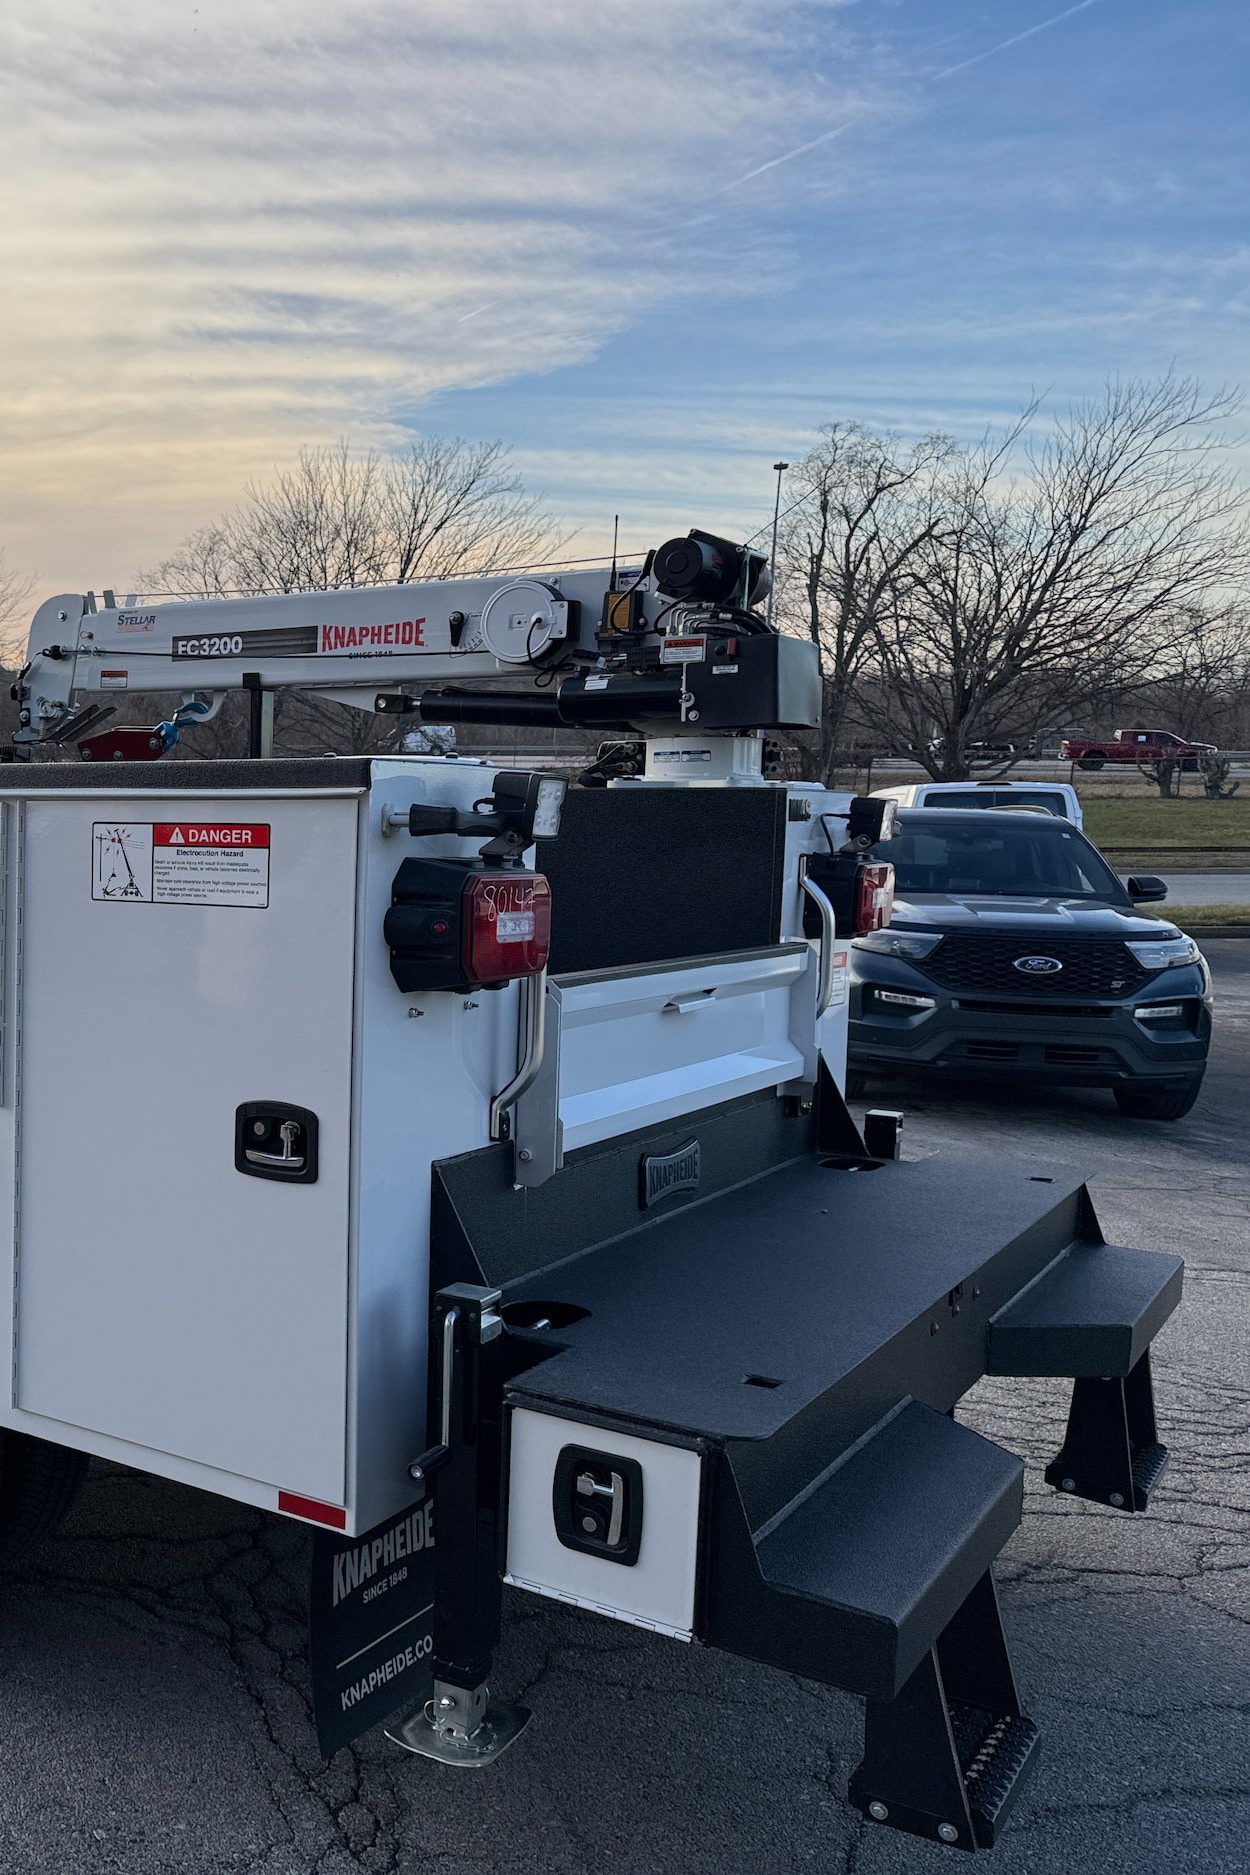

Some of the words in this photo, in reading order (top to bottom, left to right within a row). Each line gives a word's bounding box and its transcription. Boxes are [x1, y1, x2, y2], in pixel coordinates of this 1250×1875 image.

[117, 614, 156, 626] STELLAR
[178, 636, 243, 656] EC3200
[322, 617, 426, 653] KNAPHEIDE
[188, 829, 252, 844] DANGER
[176, 849, 218, 857] Electrocution
[221, 850, 244, 858] Hazard
[483, 885, 536, 922] 80147
[1025, 959, 1052, 970] Ford
[1110, 980, 1126, 988] ST
[649, 1148, 698, 1198] KNAPHEIDE
[333, 1498, 435, 1607] KNAPHEIDE
[363, 1578, 388, 1604] SINCE
[389, 1566, 408, 1588] 1848
[341, 1634, 433, 1711] KNAPHEIDE.CO
